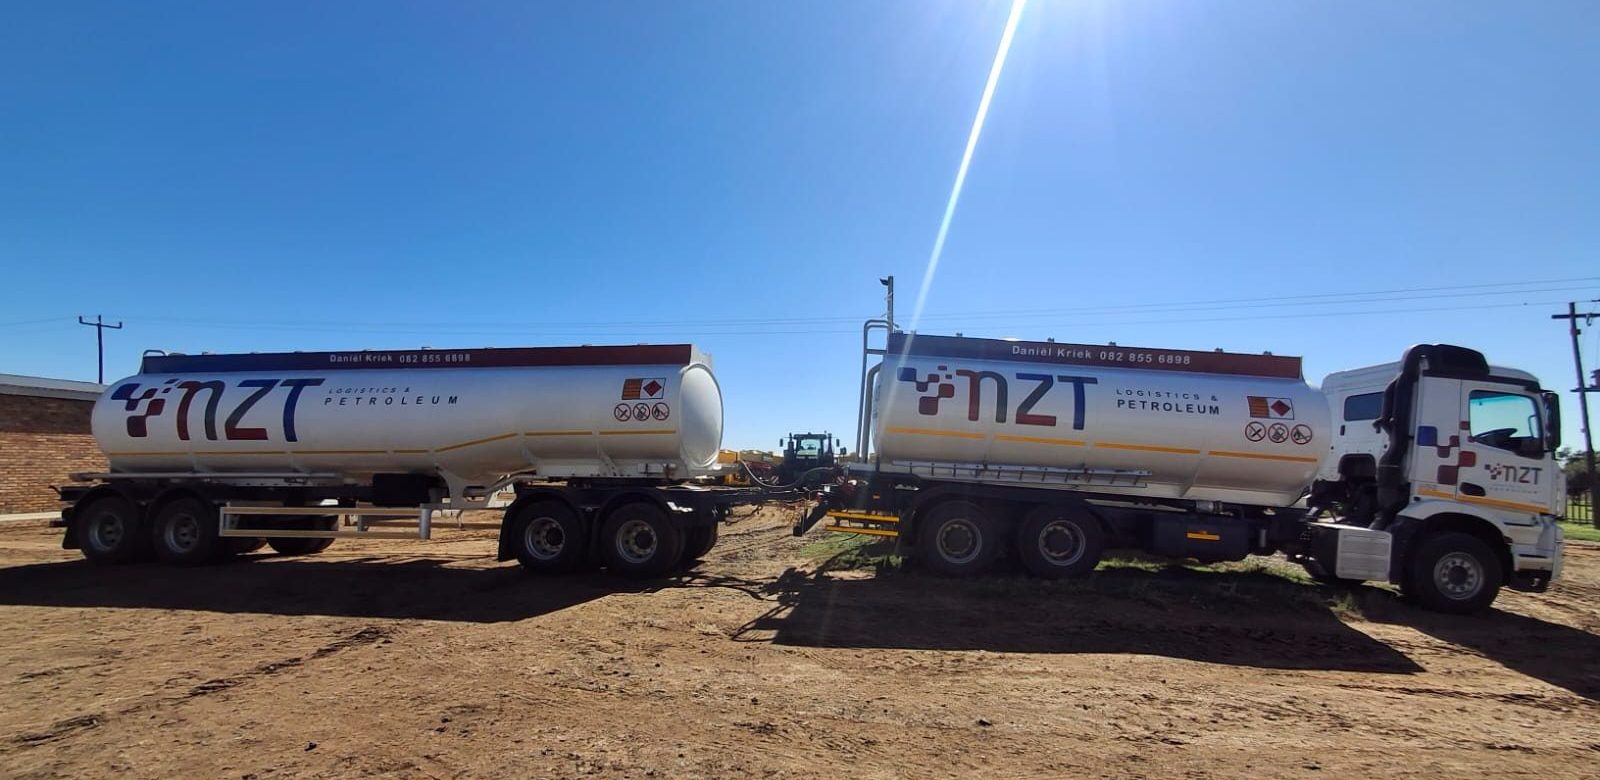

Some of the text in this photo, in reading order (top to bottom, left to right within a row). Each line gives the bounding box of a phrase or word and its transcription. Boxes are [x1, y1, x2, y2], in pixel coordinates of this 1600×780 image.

[366, 353, 393, 362] Kriek
[399, 354, 418, 364] 082
[422, 354, 441, 363] 855
[1057, 347, 1092, 360] Kriek
[1100, 351, 1124, 362] 082
[1129, 352, 1153, 364] 855
[1158, 354, 1191, 366] 6898
[1116, 389, 1200, 400] LOGISTICS
[324, 395, 458, 406] PETROLEUM
[1117, 399, 1220, 415] PETROLEUM
